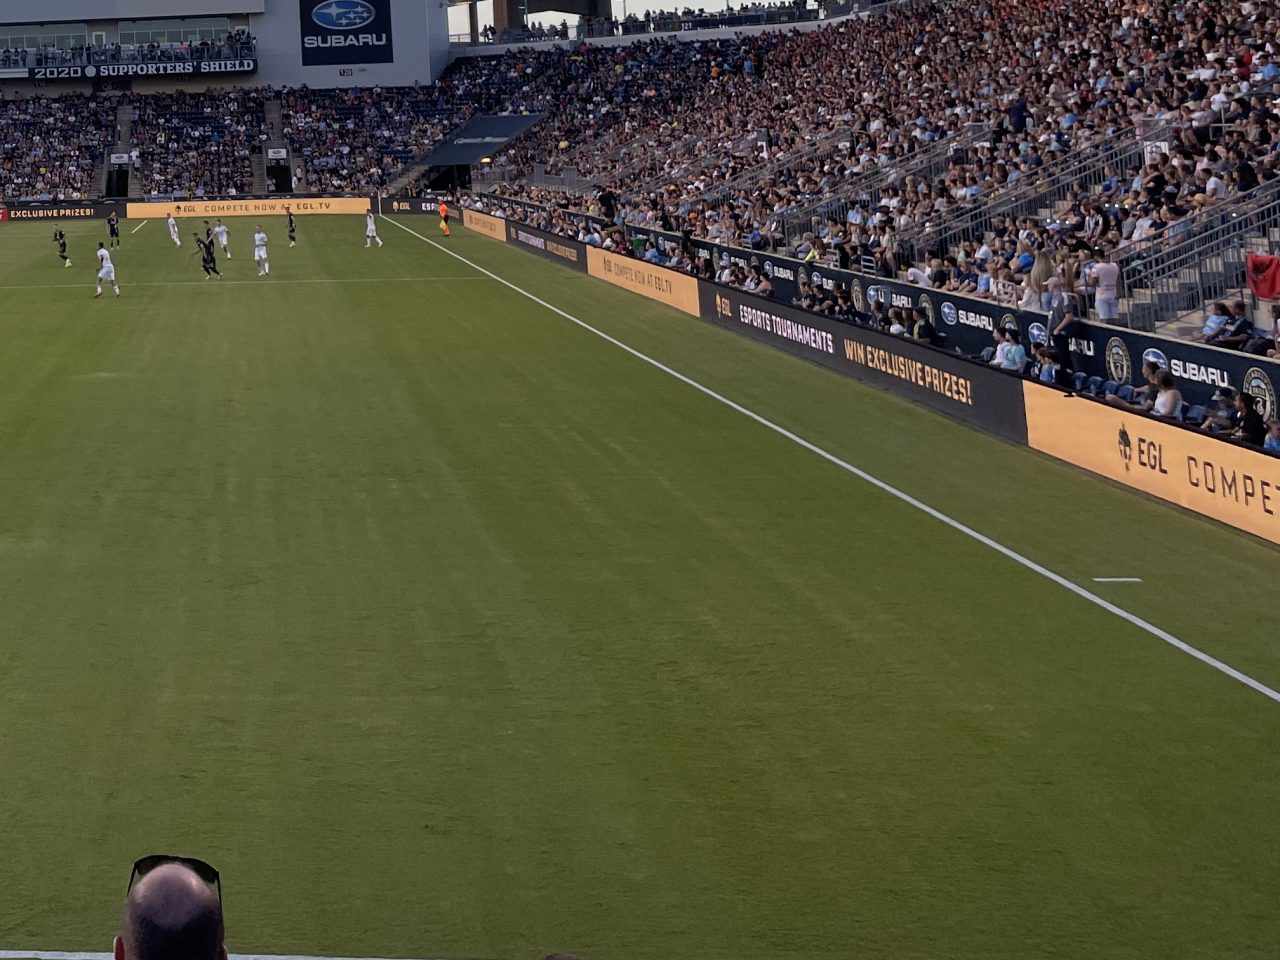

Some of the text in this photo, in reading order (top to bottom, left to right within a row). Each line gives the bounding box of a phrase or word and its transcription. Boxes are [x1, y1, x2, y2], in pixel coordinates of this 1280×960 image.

[304, 33, 387, 47] SUBARU
[34, 60, 254, 78] 2020 SUPPORTERS' SHIELD
[11, 208, 94, 218] EXCLUSIVE PRIZES!
[204, 204, 250, 212] COMPETE
[296, 202, 331, 210] EGL.TV
[773, 266, 794, 281] SUBARU
[958, 310, 994, 331] SUBARU
[721, 298, 972, 405] EGL ESPORTS TOURNAMENTS WIN EXCLUSIVE PRIZES!
[1170, 359, 1229, 387] SUBARU
[1138, 437, 1168, 474] EGL
